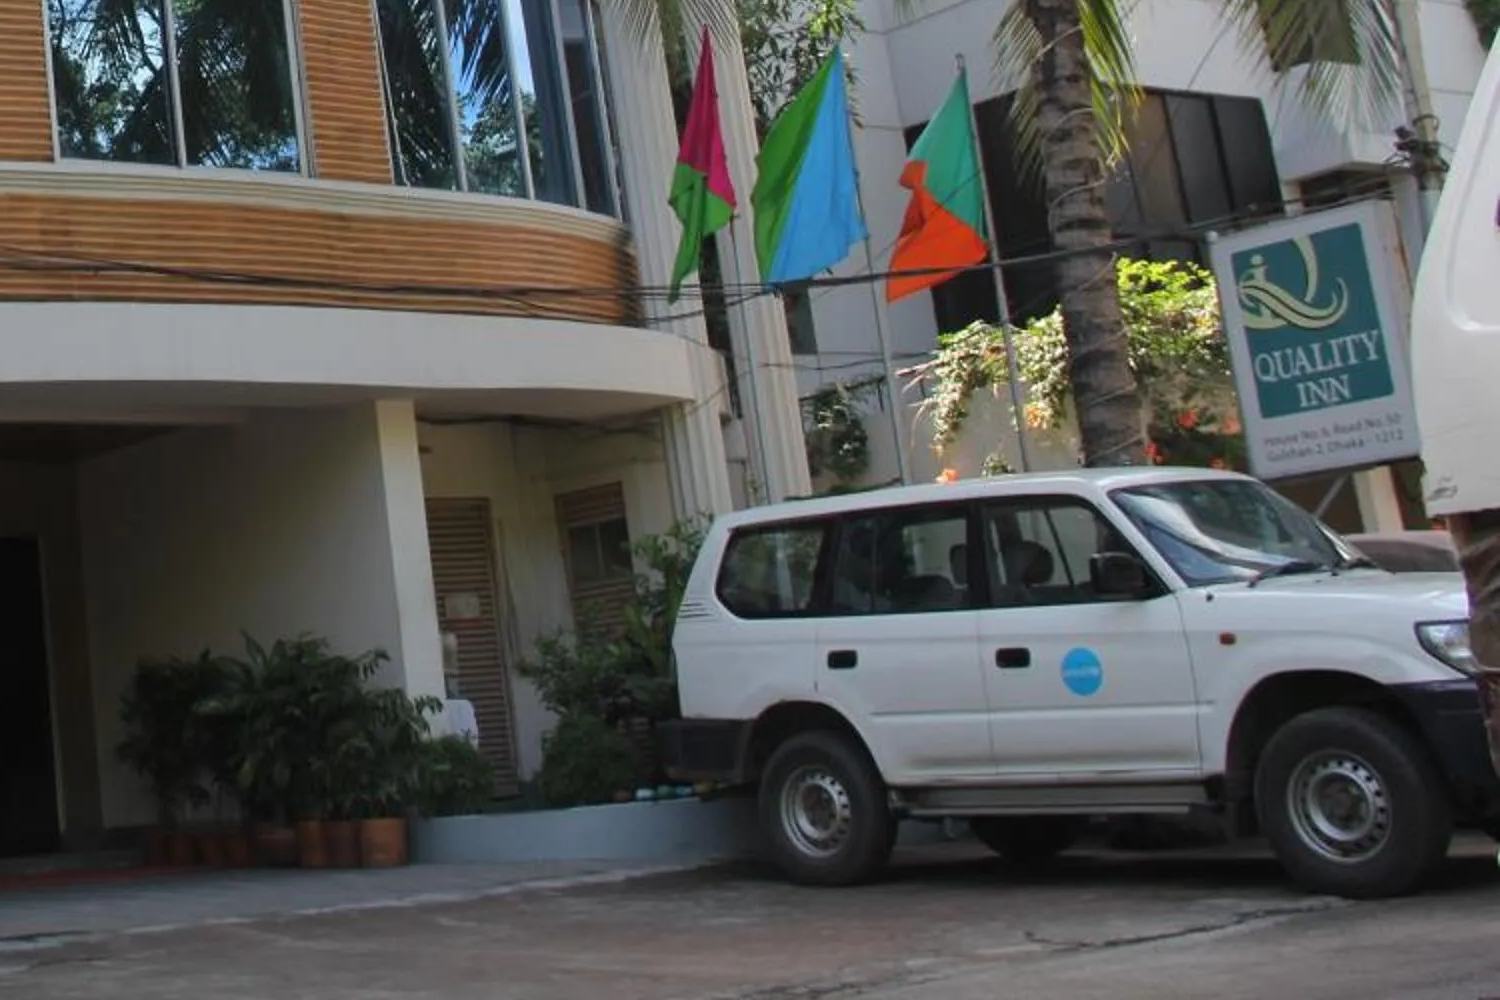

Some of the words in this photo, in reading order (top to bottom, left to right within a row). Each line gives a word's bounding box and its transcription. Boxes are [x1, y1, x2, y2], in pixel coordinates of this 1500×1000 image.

[1254, 330, 1380, 382] QUALITY
[1296, 374, 1352, 408] INN
[1375, 429, 1404, 444] 1212
